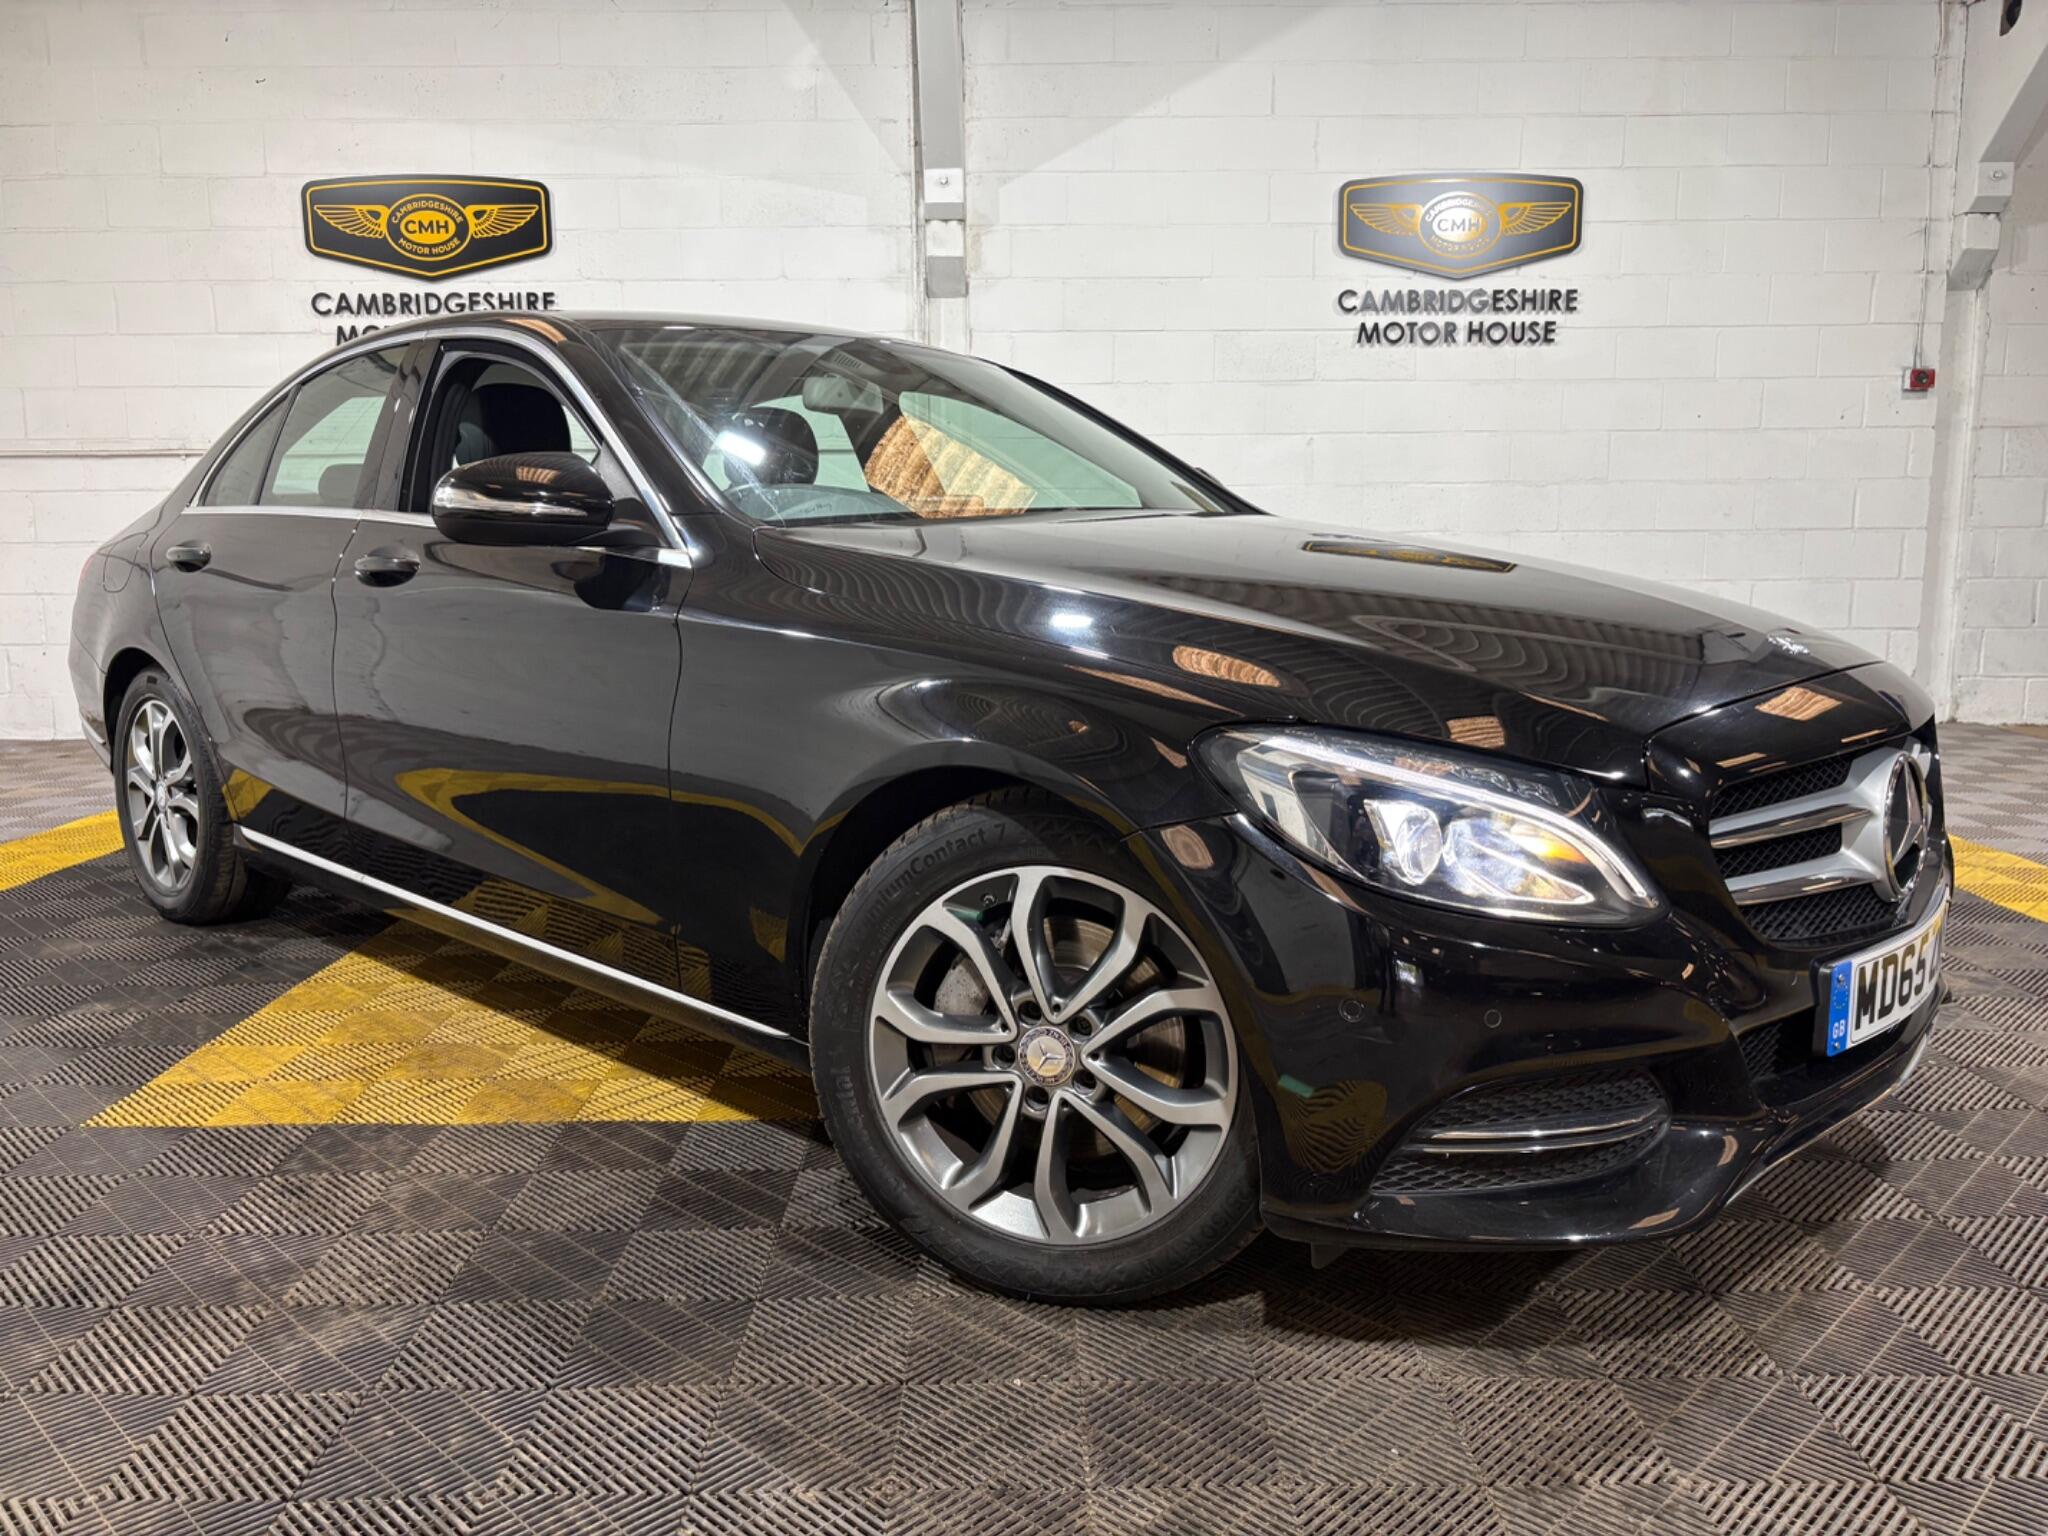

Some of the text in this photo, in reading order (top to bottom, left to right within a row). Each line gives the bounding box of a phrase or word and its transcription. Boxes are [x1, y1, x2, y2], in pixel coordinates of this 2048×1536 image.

[392, 200, 464, 224] CAMBRIDGESHIRE
[404, 220, 449, 234] CMH
[1437, 218, 1480, 232] CMH
[399, 237, 461, 255] MOTOR HOUSE
[311, 292, 556, 316] CAMBRIDGESHIRE
[1338, 289, 1579, 313] CAMBRIDGESHIRE
[1357, 321, 1556, 344] MOTOR HOUSE
[857, 823, 1006, 933] miumContact 7
[1854, 933, 1929, 1031] MD65
[1832, 1019, 1846, 1039] GB
